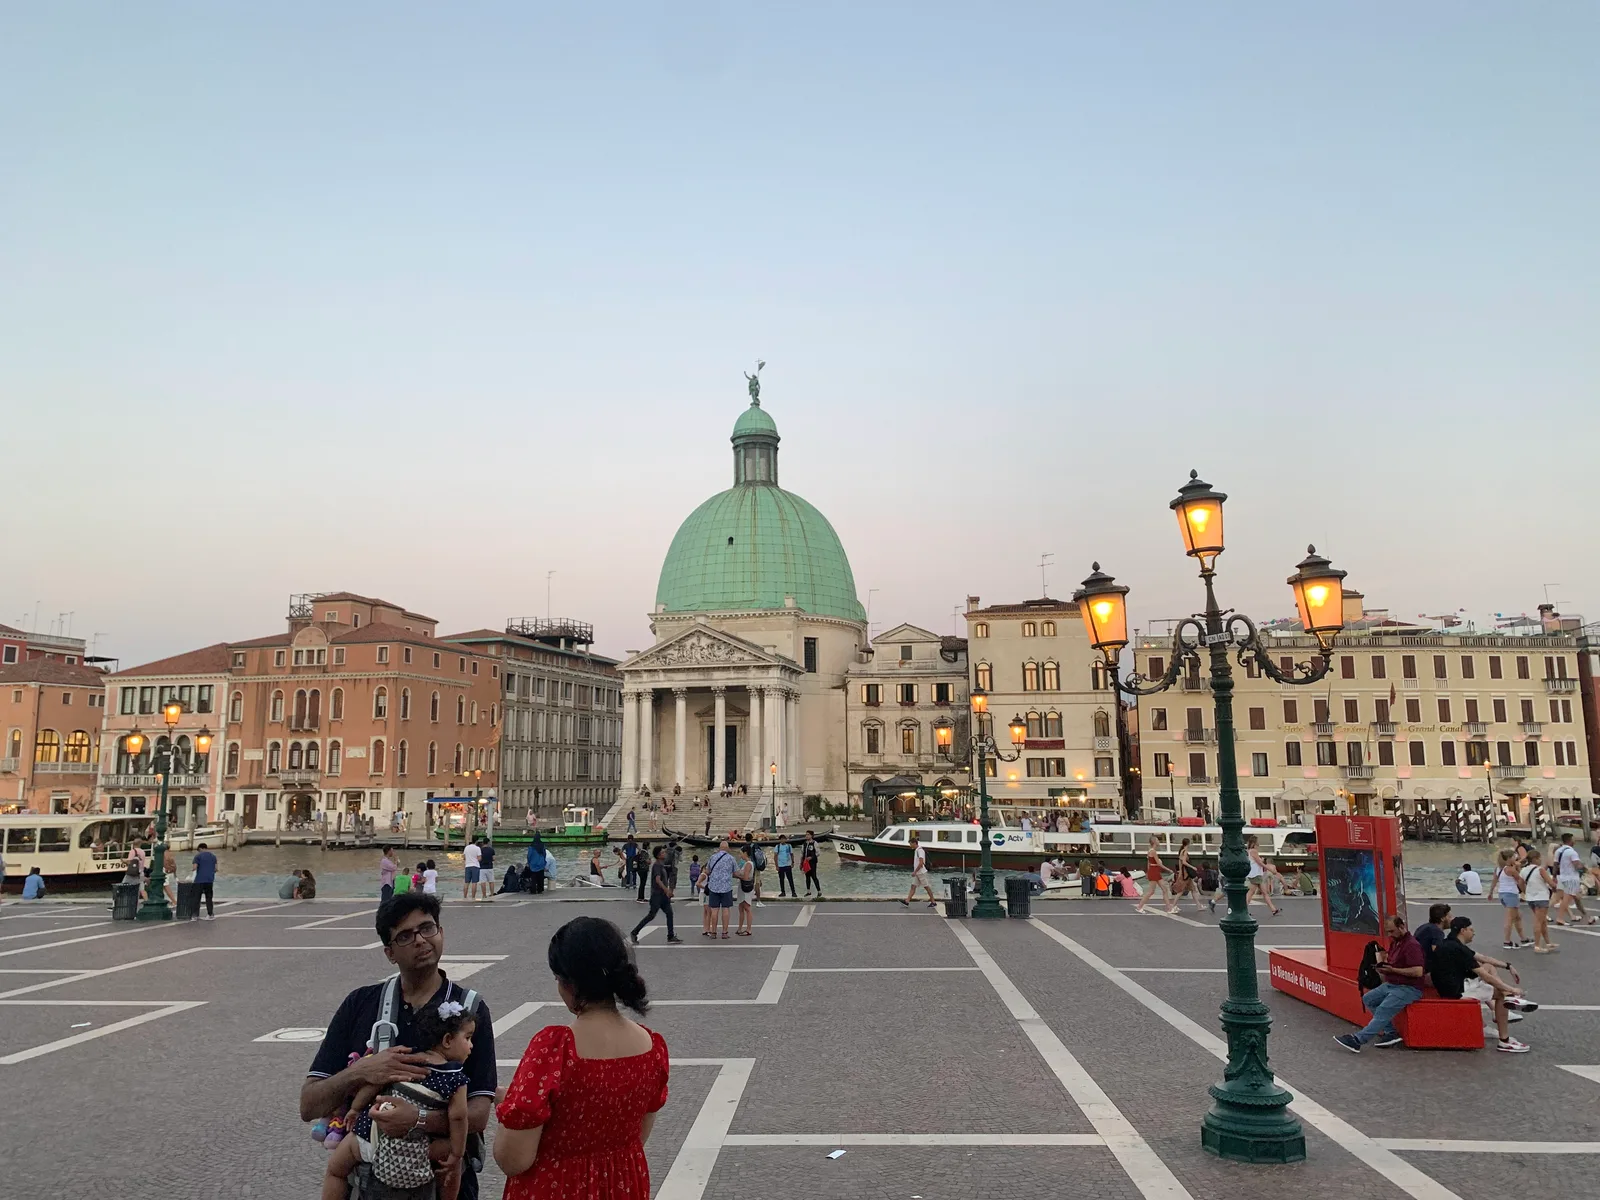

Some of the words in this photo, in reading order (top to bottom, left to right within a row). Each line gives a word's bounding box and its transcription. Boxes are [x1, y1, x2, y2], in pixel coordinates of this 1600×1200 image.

[1408, 724, 1435, 732] Grand
[1439, 724, 1463, 732] Canal
[839, 842, 856, 851] 280
[1272, 963, 1277, 976] La
[1277, 965, 1299, 985] Biennale
[1299, 973, 1305, 988] di
[1304, 976, 1326, 997] Venezia
